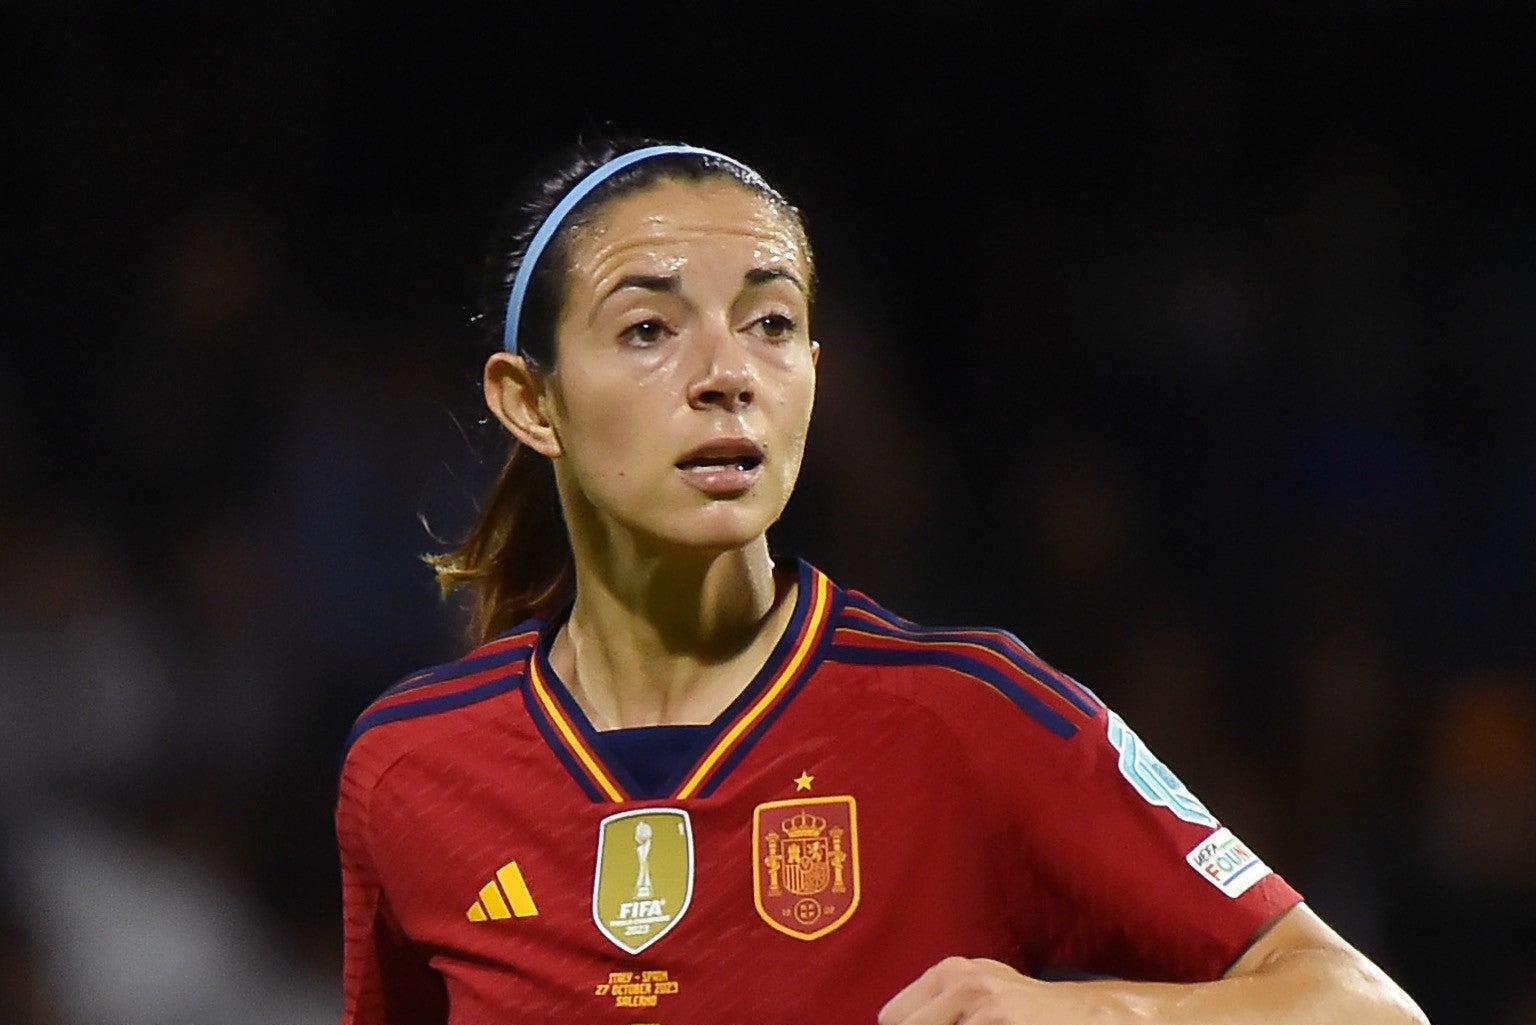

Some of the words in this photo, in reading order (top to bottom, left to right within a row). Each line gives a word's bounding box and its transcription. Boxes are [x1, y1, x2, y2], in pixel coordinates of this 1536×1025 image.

[620, 900, 662, 919] FIFA
[595, 984, 610, 996] 27
[611, 983, 652, 996] OCTOBER
